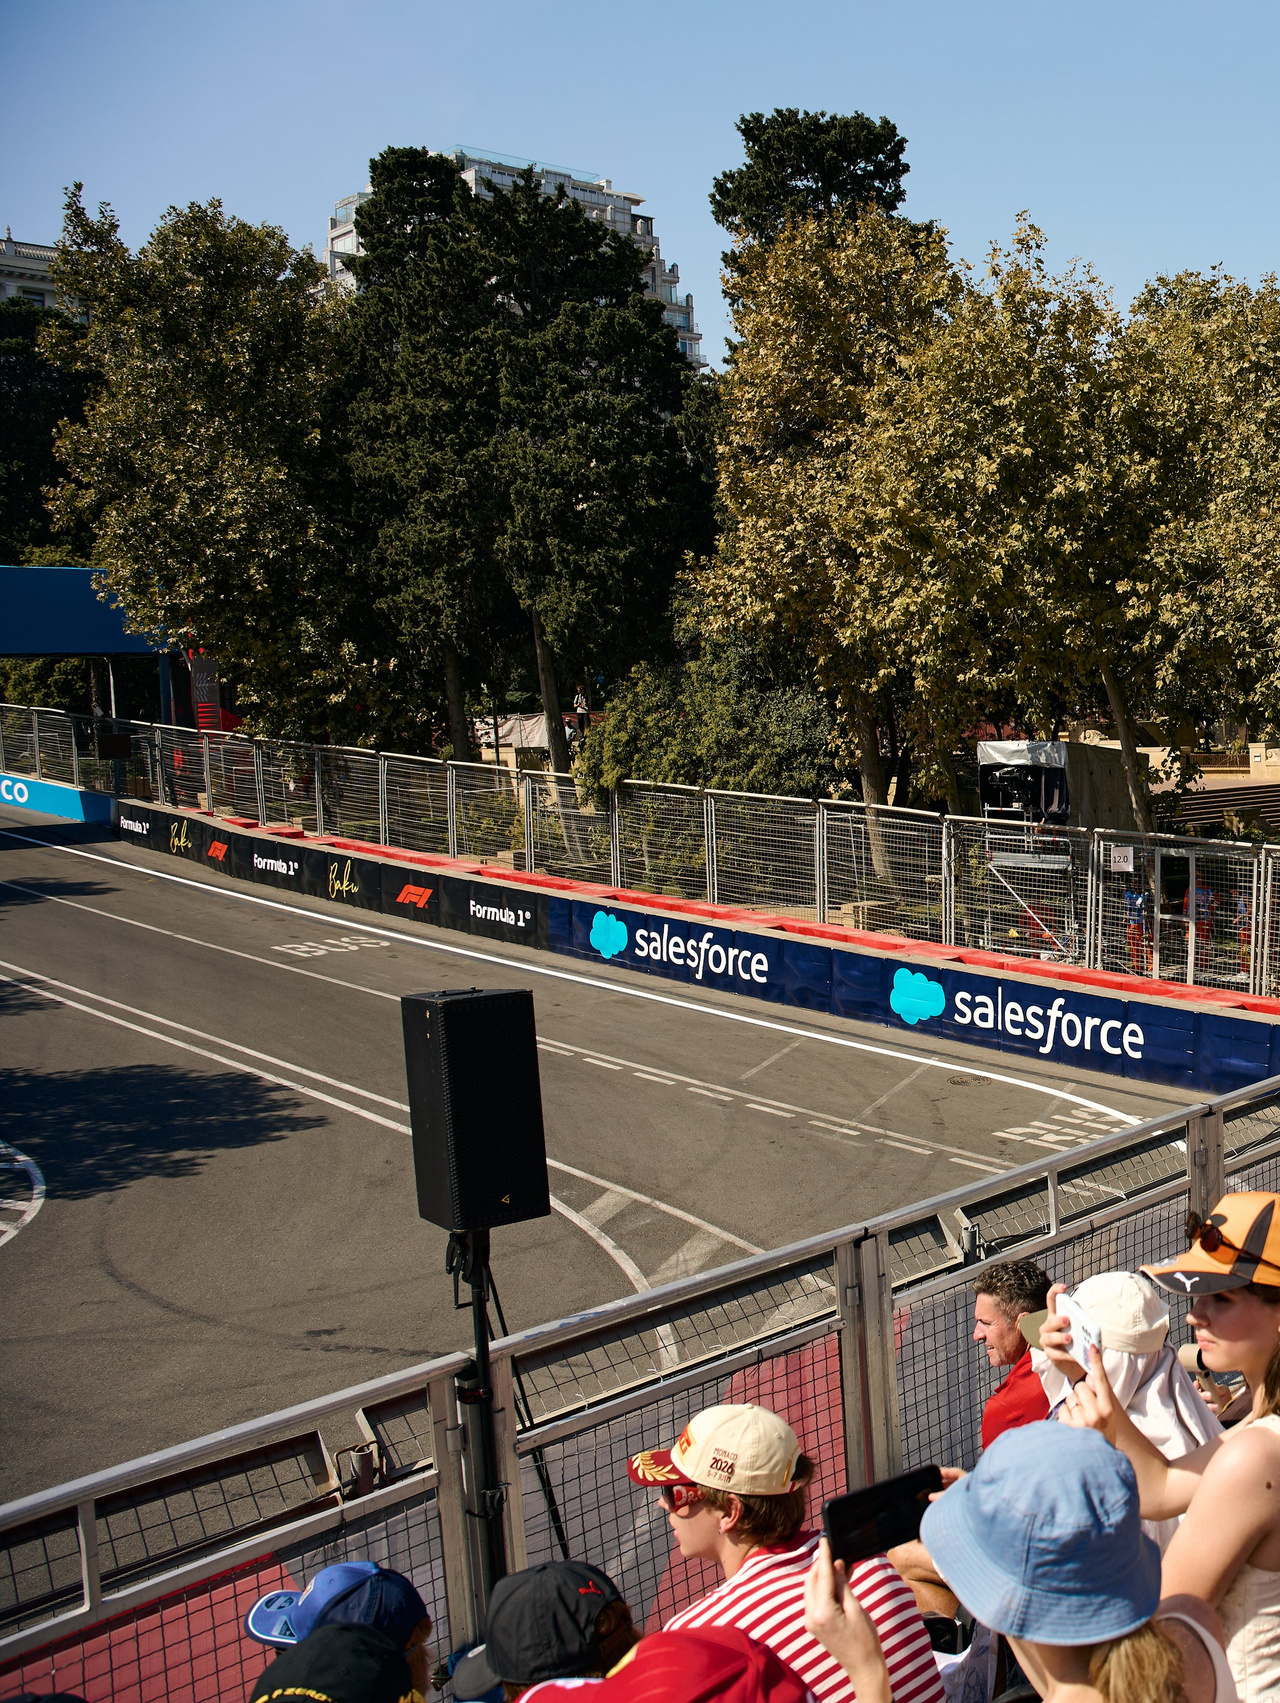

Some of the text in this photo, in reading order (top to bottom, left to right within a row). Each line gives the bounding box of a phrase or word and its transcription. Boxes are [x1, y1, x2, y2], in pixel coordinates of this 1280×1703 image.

[120, 816, 142, 834] Formula
[253, 853, 287, 875] Formula
[1113, 855, 1129, 863] 12.0
[328, 859, 360, 899] Baku
[469, 899, 515, 926] Formula
[270, 936, 391, 957] BUS
[634, 923, 769, 984] salesforce
[953, 986, 1145, 1059] salesforce
[713, 1447, 738, 1461] MONACO
[707, 1470, 718, 1478] 5-7
[709, 1457, 735, 1475] 2026
